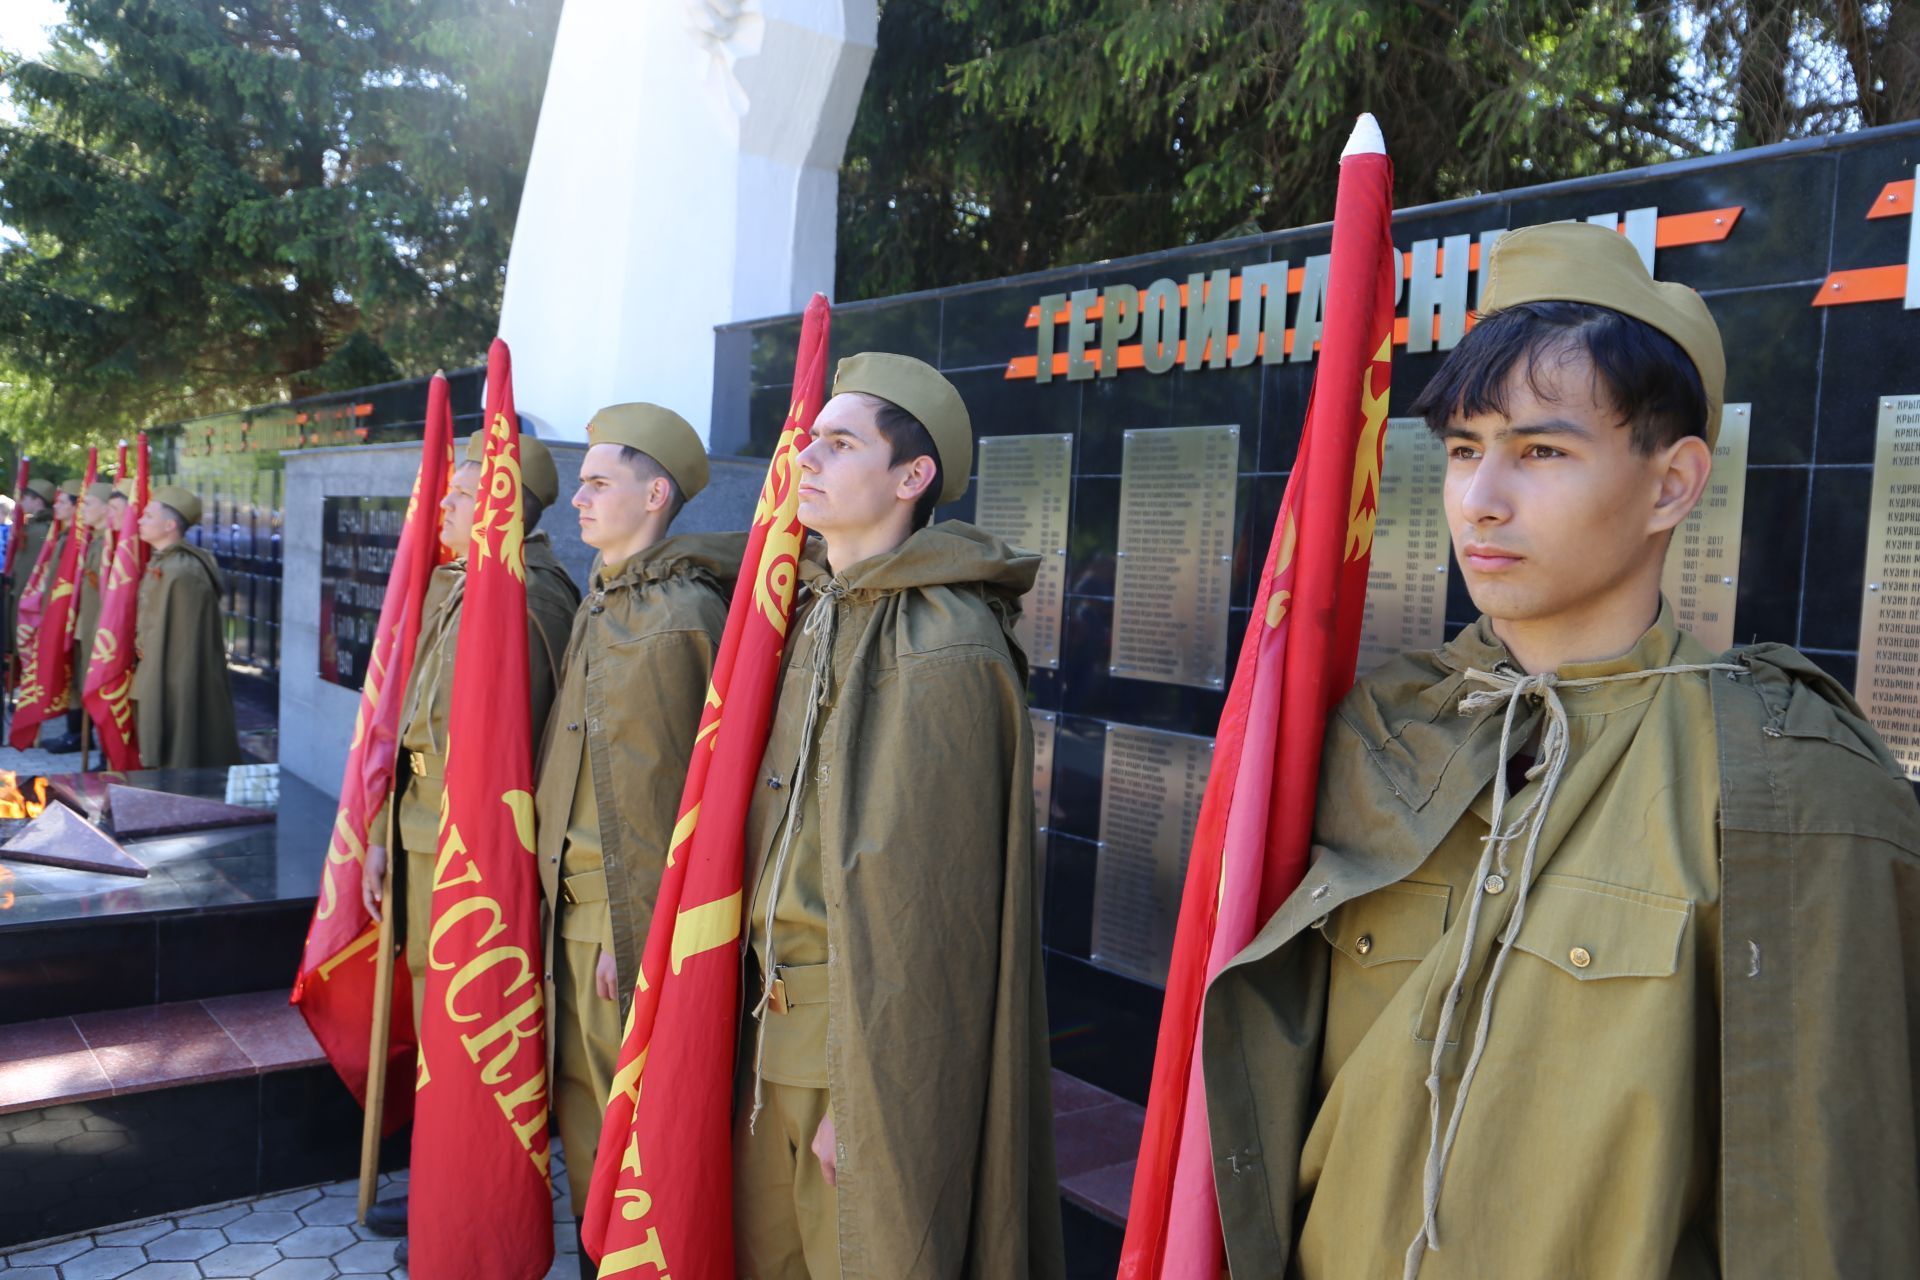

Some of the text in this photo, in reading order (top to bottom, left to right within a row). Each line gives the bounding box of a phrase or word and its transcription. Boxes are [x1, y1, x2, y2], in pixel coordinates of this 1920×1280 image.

[1895, 428, 1920, 437] КРЮК
[1885, 540, 1913, 550] КУЗИН
[1884, 554, 1911, 563] КУЗИН
[1883, 568, 1910, 577] КУЗИН
[1882, 581, 1909, 591] КУЗИН
[1881, 595, 1908, 605] КУЗИН
[1879, 609, 1906, 619] КУЗИН
[1877, 636, 1920, 648] КУЗНЕЦОВ
[1876, 650, 1919, 662] КУЗНЕЦОВ
[1875, 664, 1915, 676] КУЗЬМИН
[1873, 677, 1914, 690] КУЗЬМИН
[1872, 691, 1918, 704] КУЗЬМИНА
